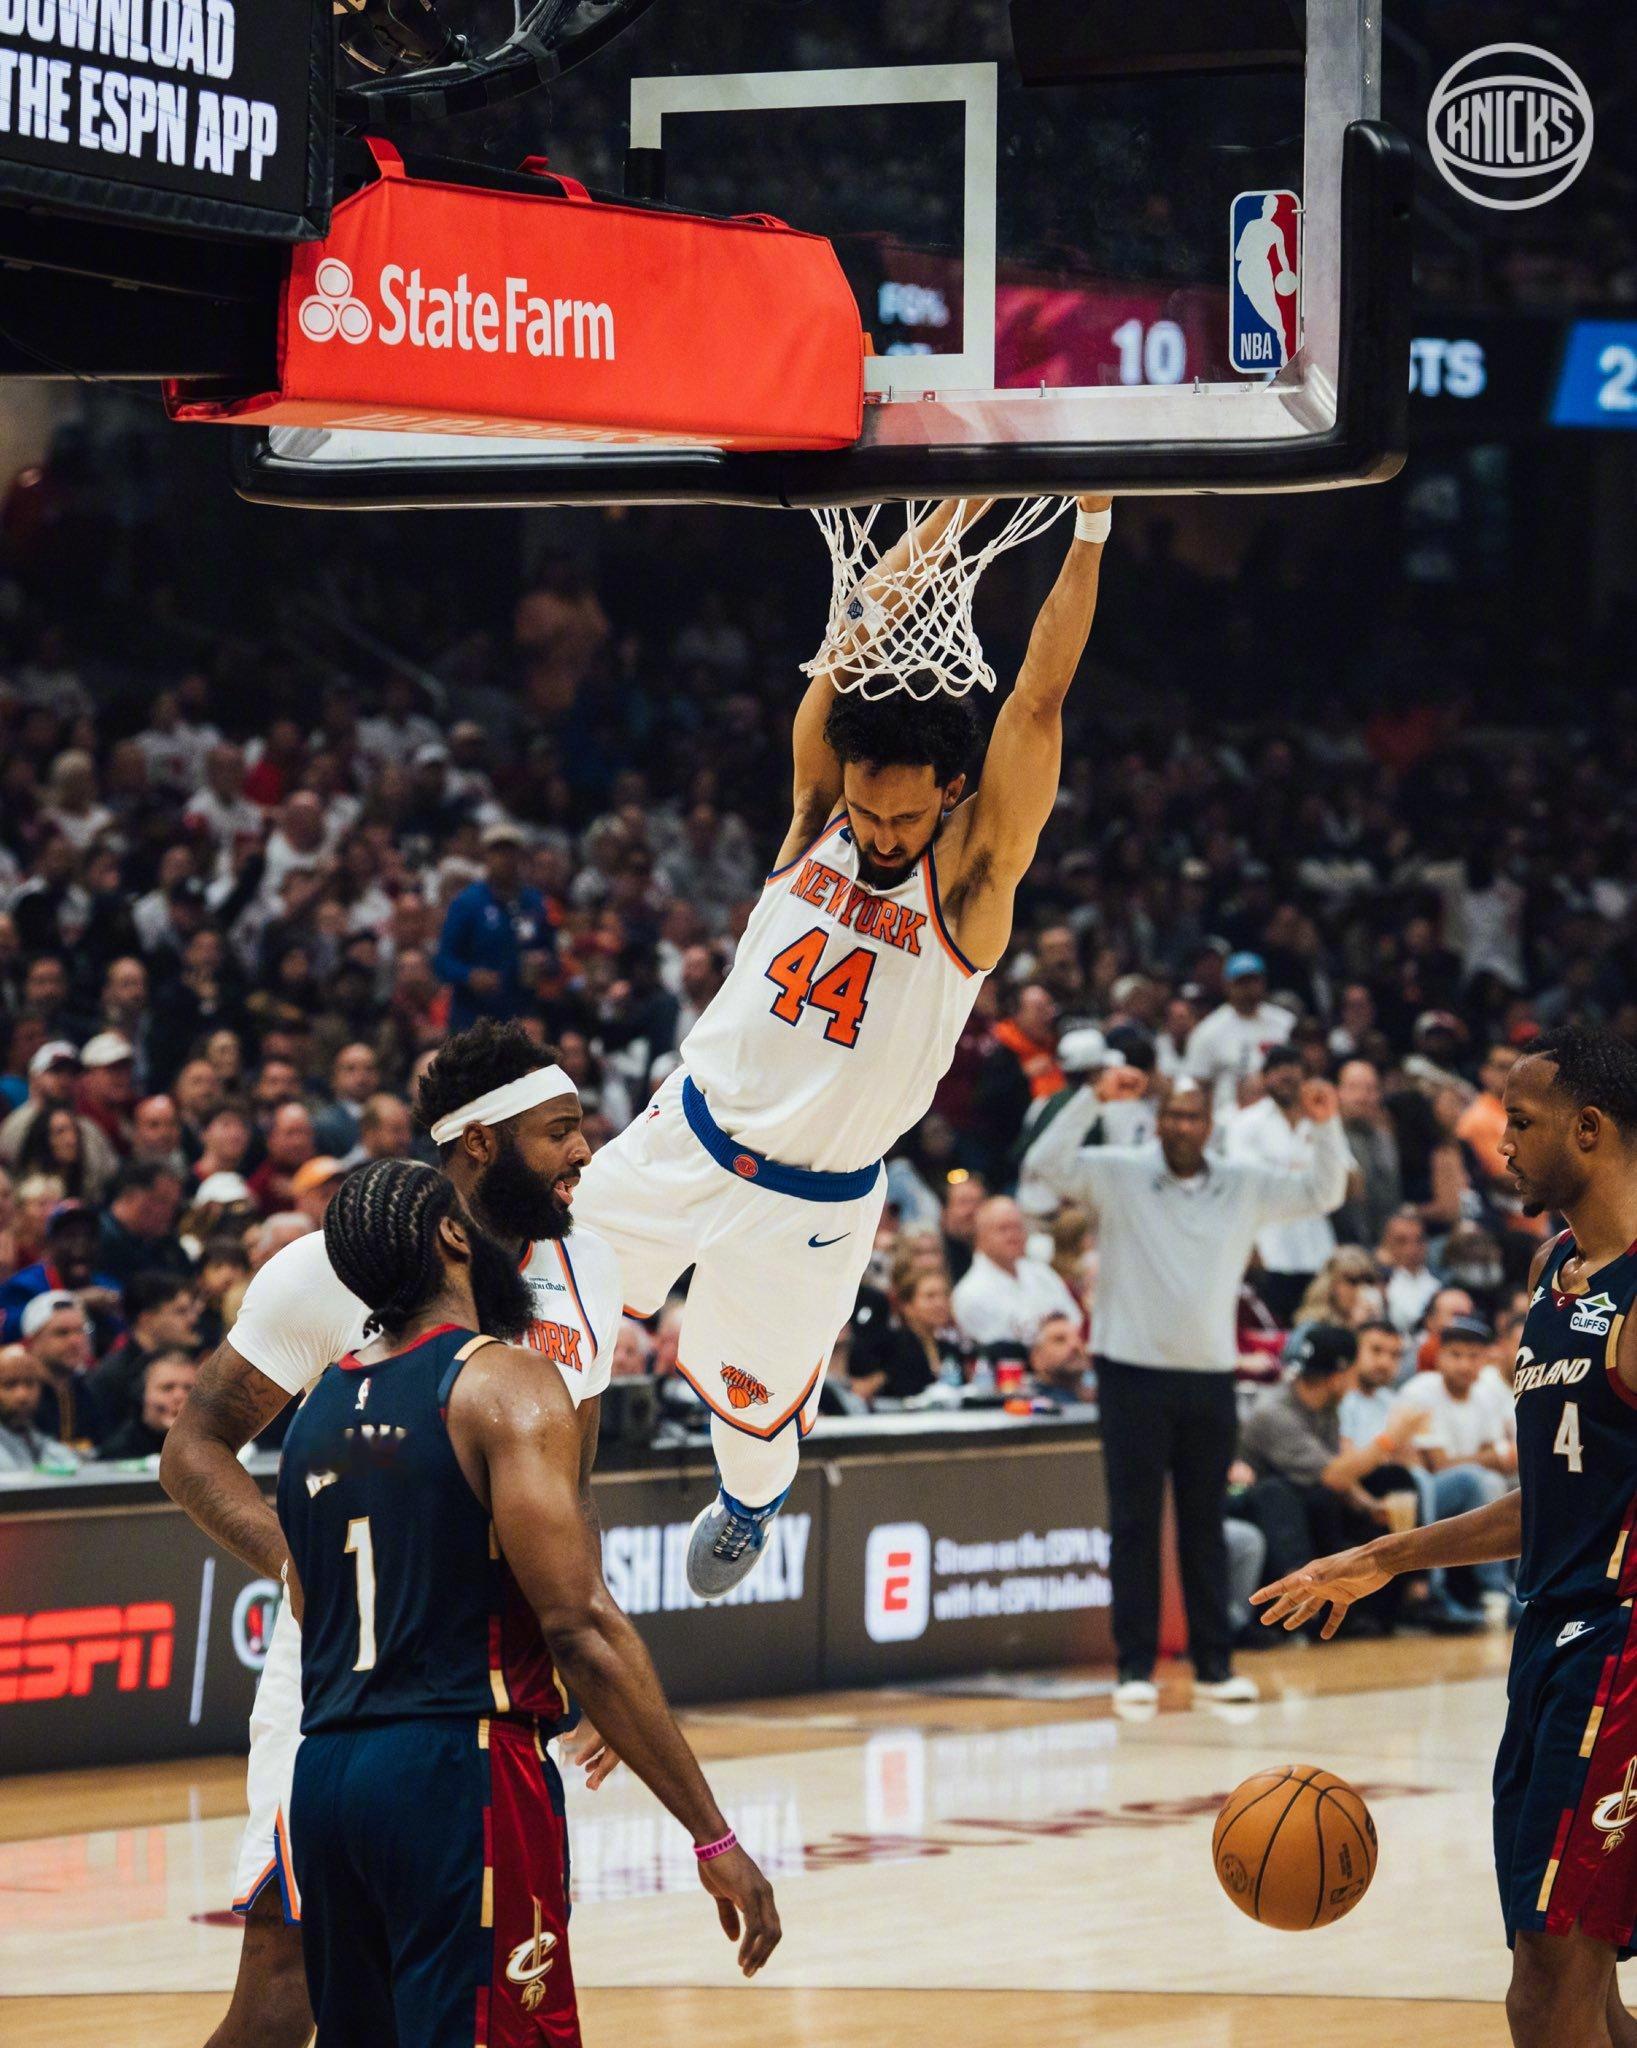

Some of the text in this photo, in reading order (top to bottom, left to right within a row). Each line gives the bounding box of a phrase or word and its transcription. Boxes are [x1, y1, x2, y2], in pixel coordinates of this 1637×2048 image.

[0, 0, 235, 79] DOWNLOAD
[79, 66, 188, 166] ESPN
[194, 90, 278, 181] APP
[1111, 318, 1186, 386] 10
[1240, 332, 1273, 361] NBA
[789, 858, 928, 957] NEW YORK
[764, 926, 877, 1049] 44
[1572, 1316, 1608, 1333] CLIFFS
[1553, 1401, 1584, 1473] 4
[343, 1516, 377, 1672] 1
